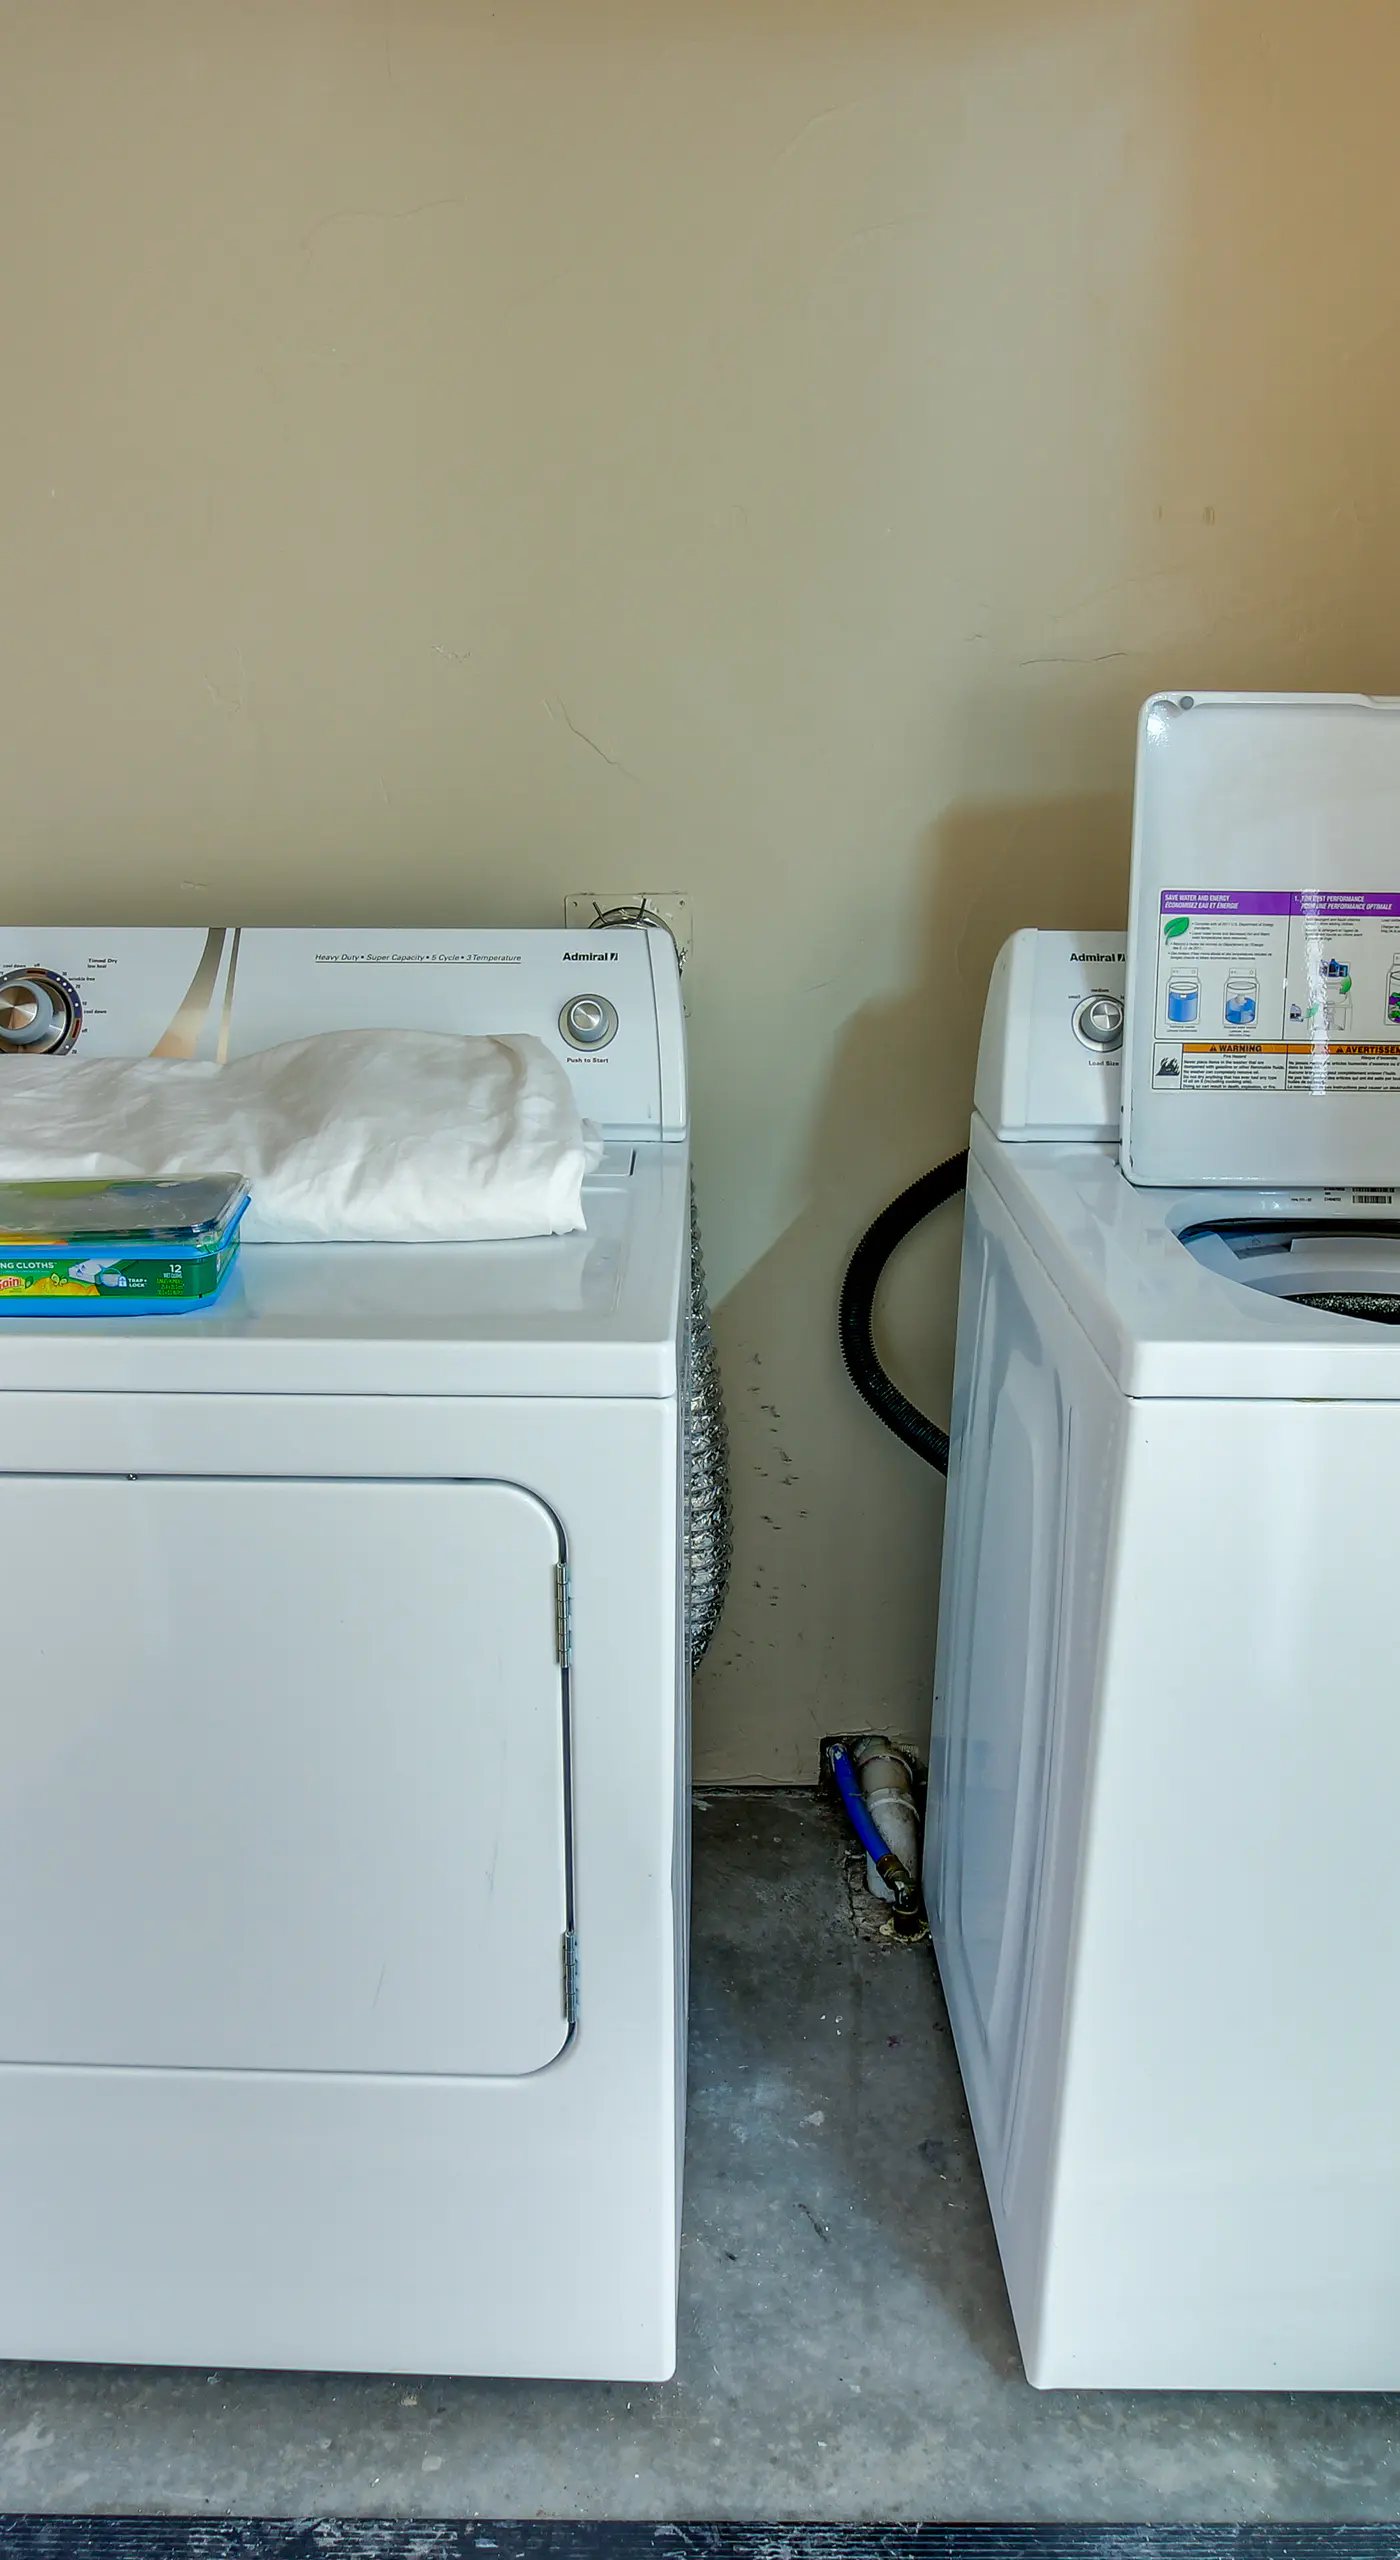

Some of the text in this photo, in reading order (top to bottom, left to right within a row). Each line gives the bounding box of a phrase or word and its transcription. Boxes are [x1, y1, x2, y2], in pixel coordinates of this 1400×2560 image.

[315, 954, 339, 962] Heavy
[341, 954, 360, 962] Duty
[366, 954, 389, 962] Super
[391, 954, 424, 962] Capacity
[438, 954, 459, 962] Cycle
[563, 953, 608, 961] Admiral
[1070, 953, 1115, 962] Admiral
[169, 1264, 182, 1273] 12
[0, 1277, 20, 1290] ain
